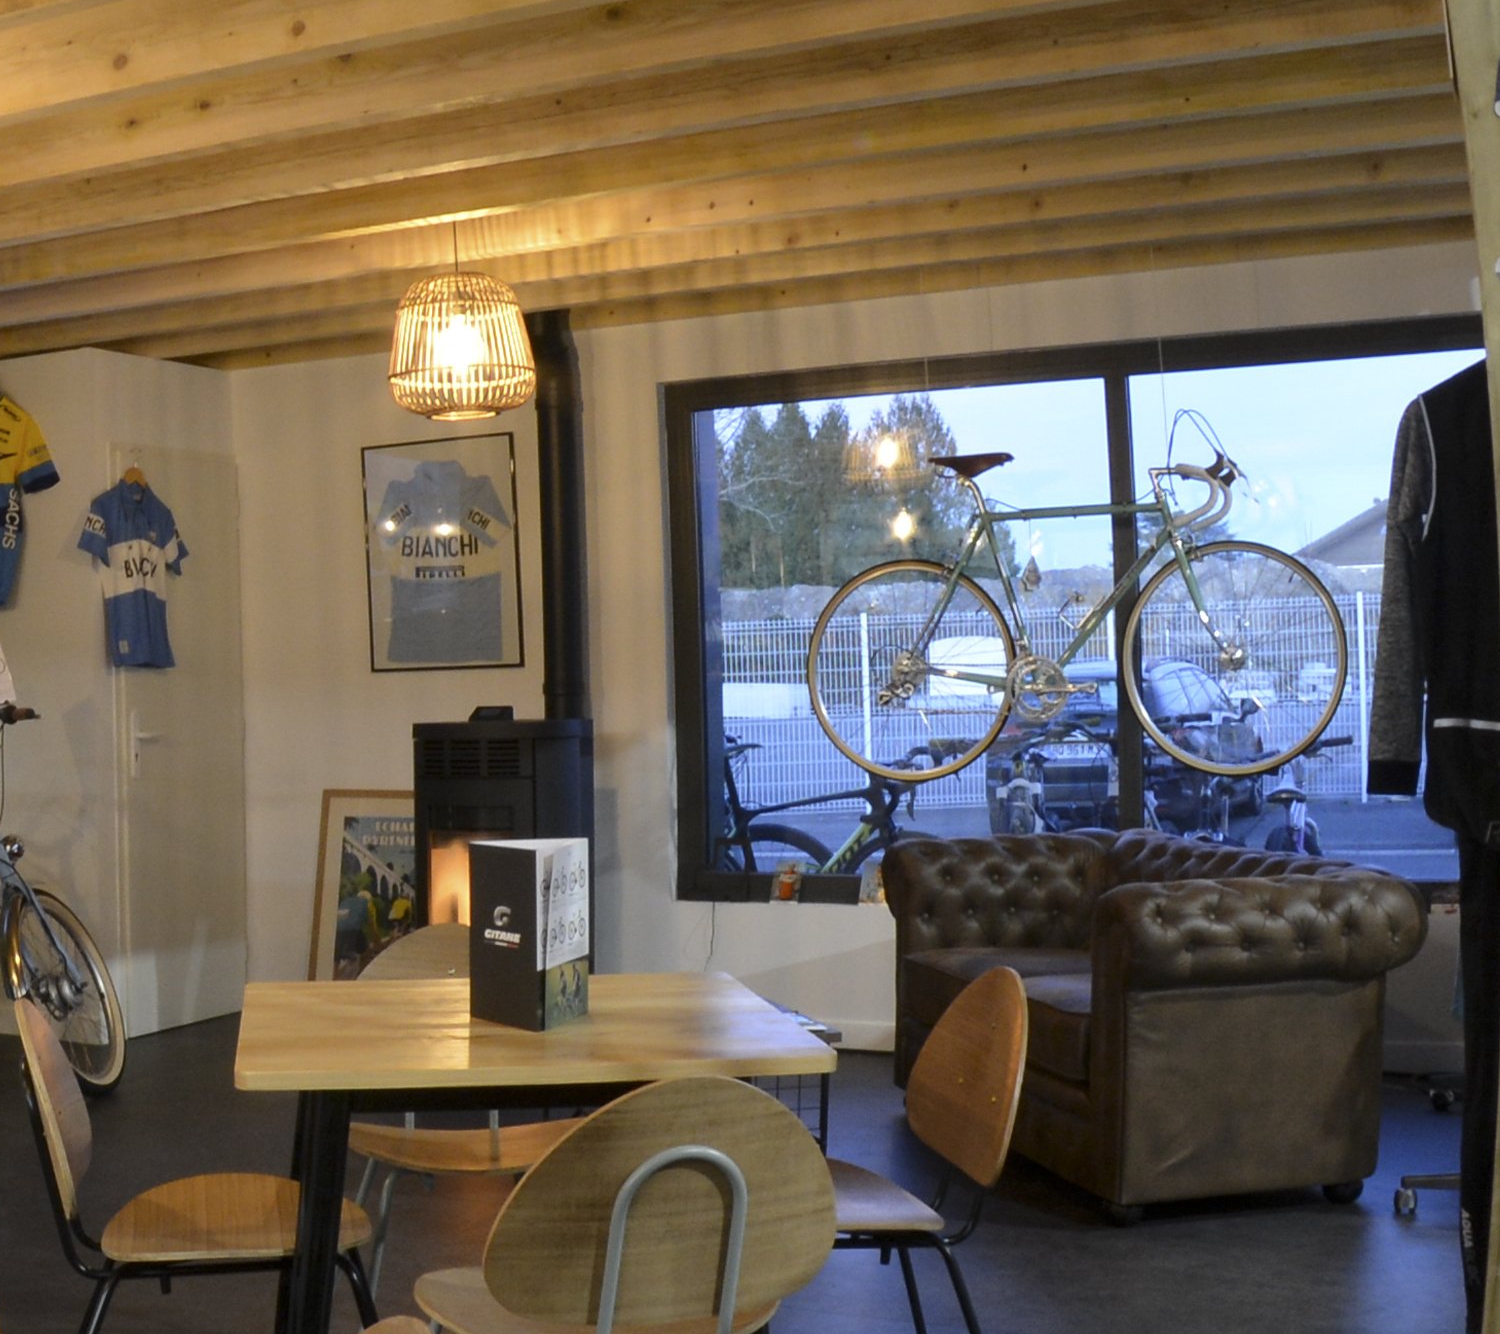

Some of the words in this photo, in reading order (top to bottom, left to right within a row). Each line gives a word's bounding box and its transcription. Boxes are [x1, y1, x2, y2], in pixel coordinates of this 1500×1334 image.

[1, 486, 20, 551] SACHS
[401, 534, 479, 558] BIANCHI
[483, 928, 522, 944] GITANE
